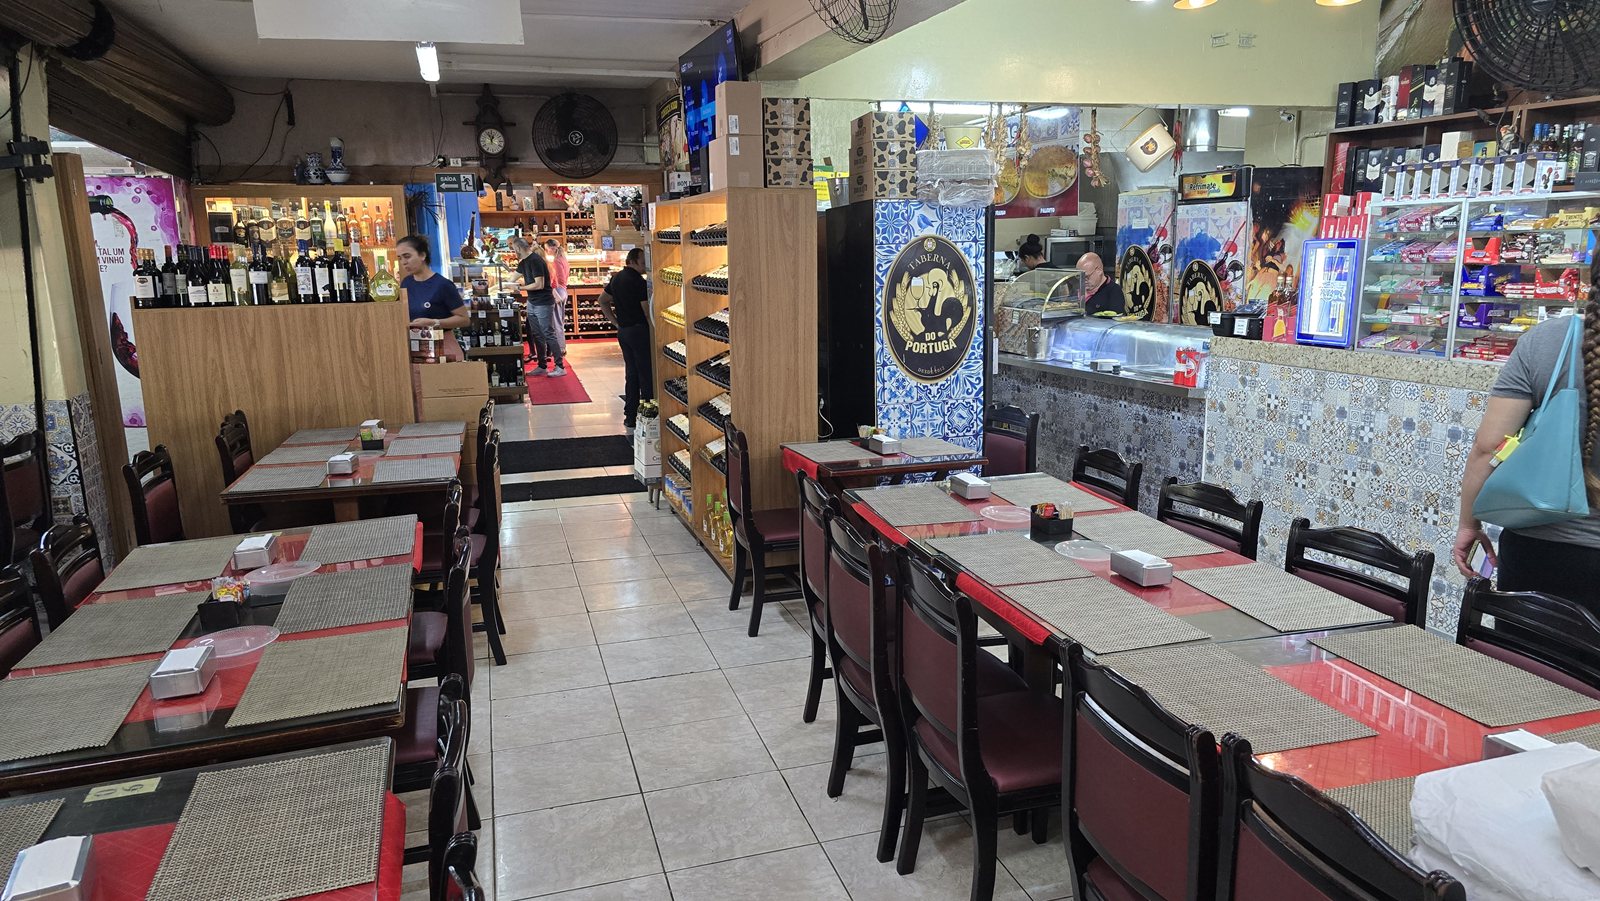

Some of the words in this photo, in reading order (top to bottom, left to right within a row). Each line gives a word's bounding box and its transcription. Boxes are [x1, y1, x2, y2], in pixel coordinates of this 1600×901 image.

[98, 248, 111, 256] TAL
[113, 248, 125, 256] UM
[101, 256, 125, 264] VINHO
[908, 253, 951, 270] TABERNA
[925, 331, 936, 341] DO
[905, 338, 957, 354] PORTUGA
